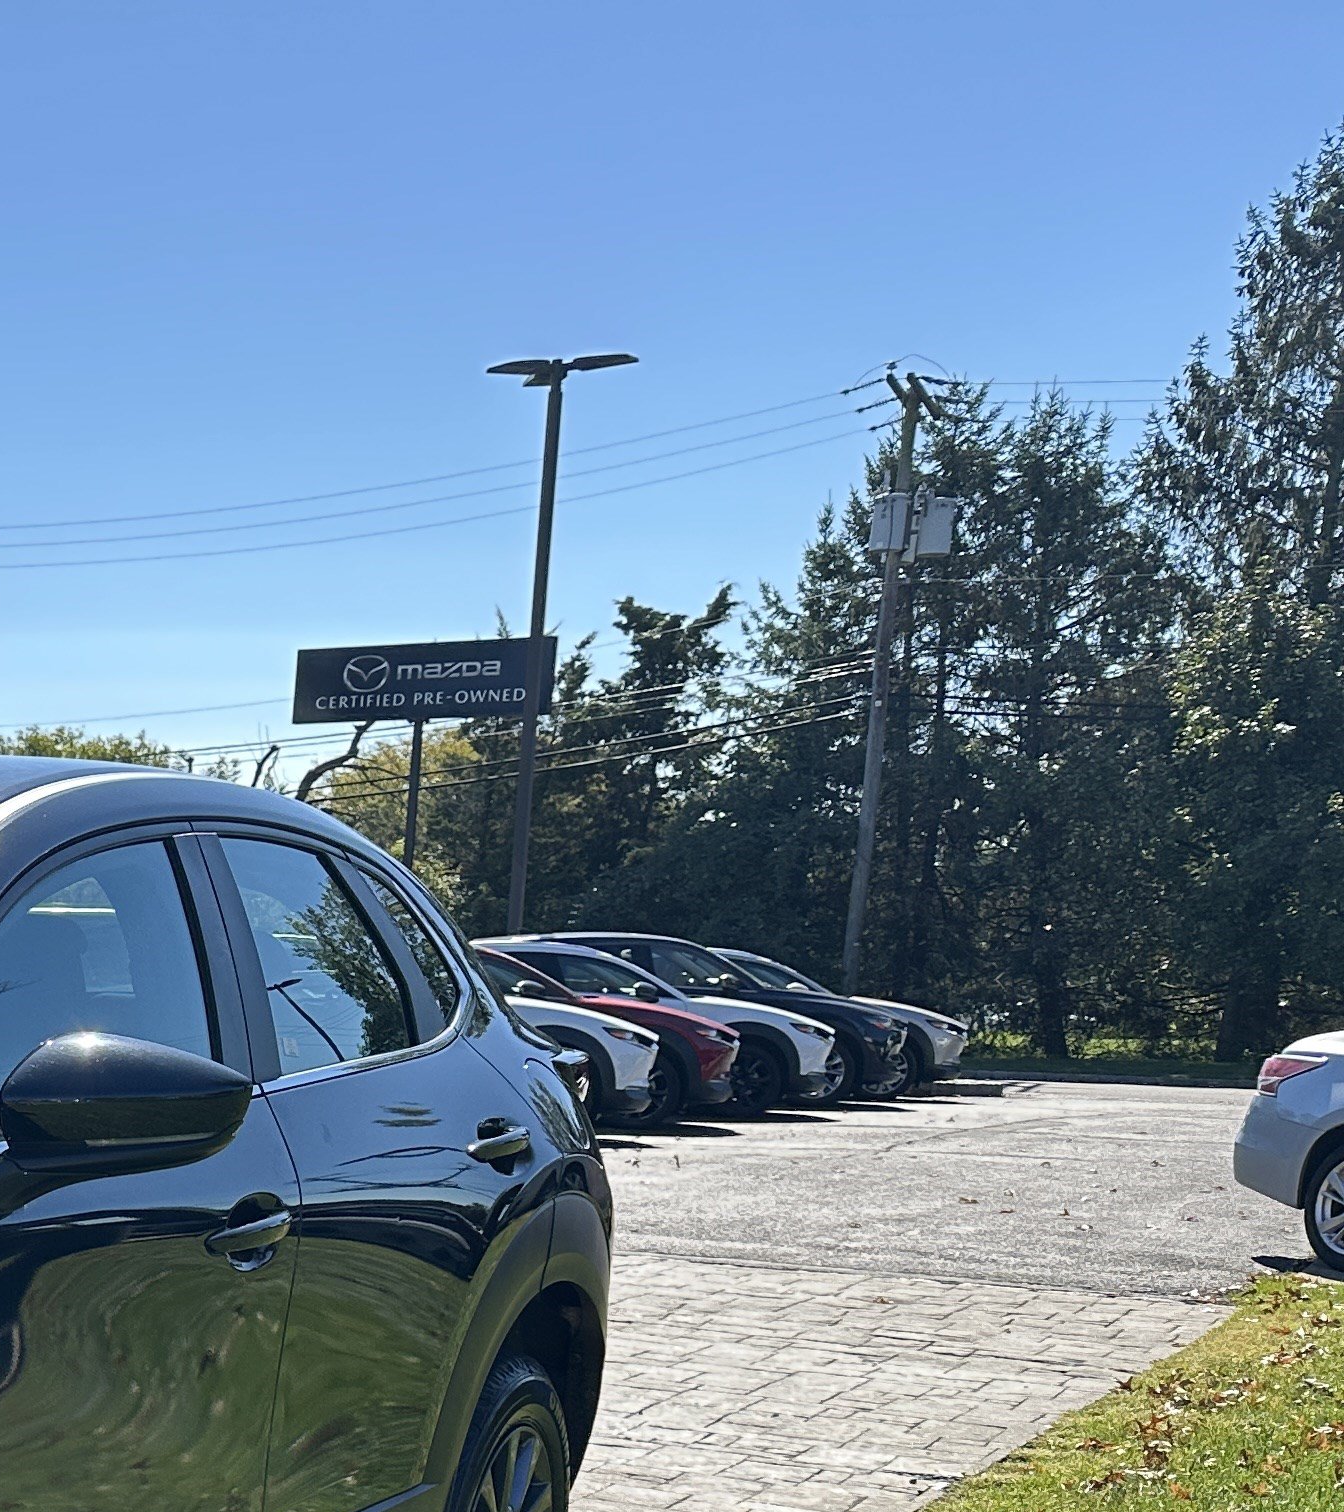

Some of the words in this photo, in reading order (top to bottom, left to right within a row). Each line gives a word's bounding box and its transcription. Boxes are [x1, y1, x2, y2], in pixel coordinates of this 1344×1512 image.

[396, 660, 501, 681] mazda
[315, 693, 406, 710] CERTIFIED
[413, 687, 526, 706] PRE-OWNED
